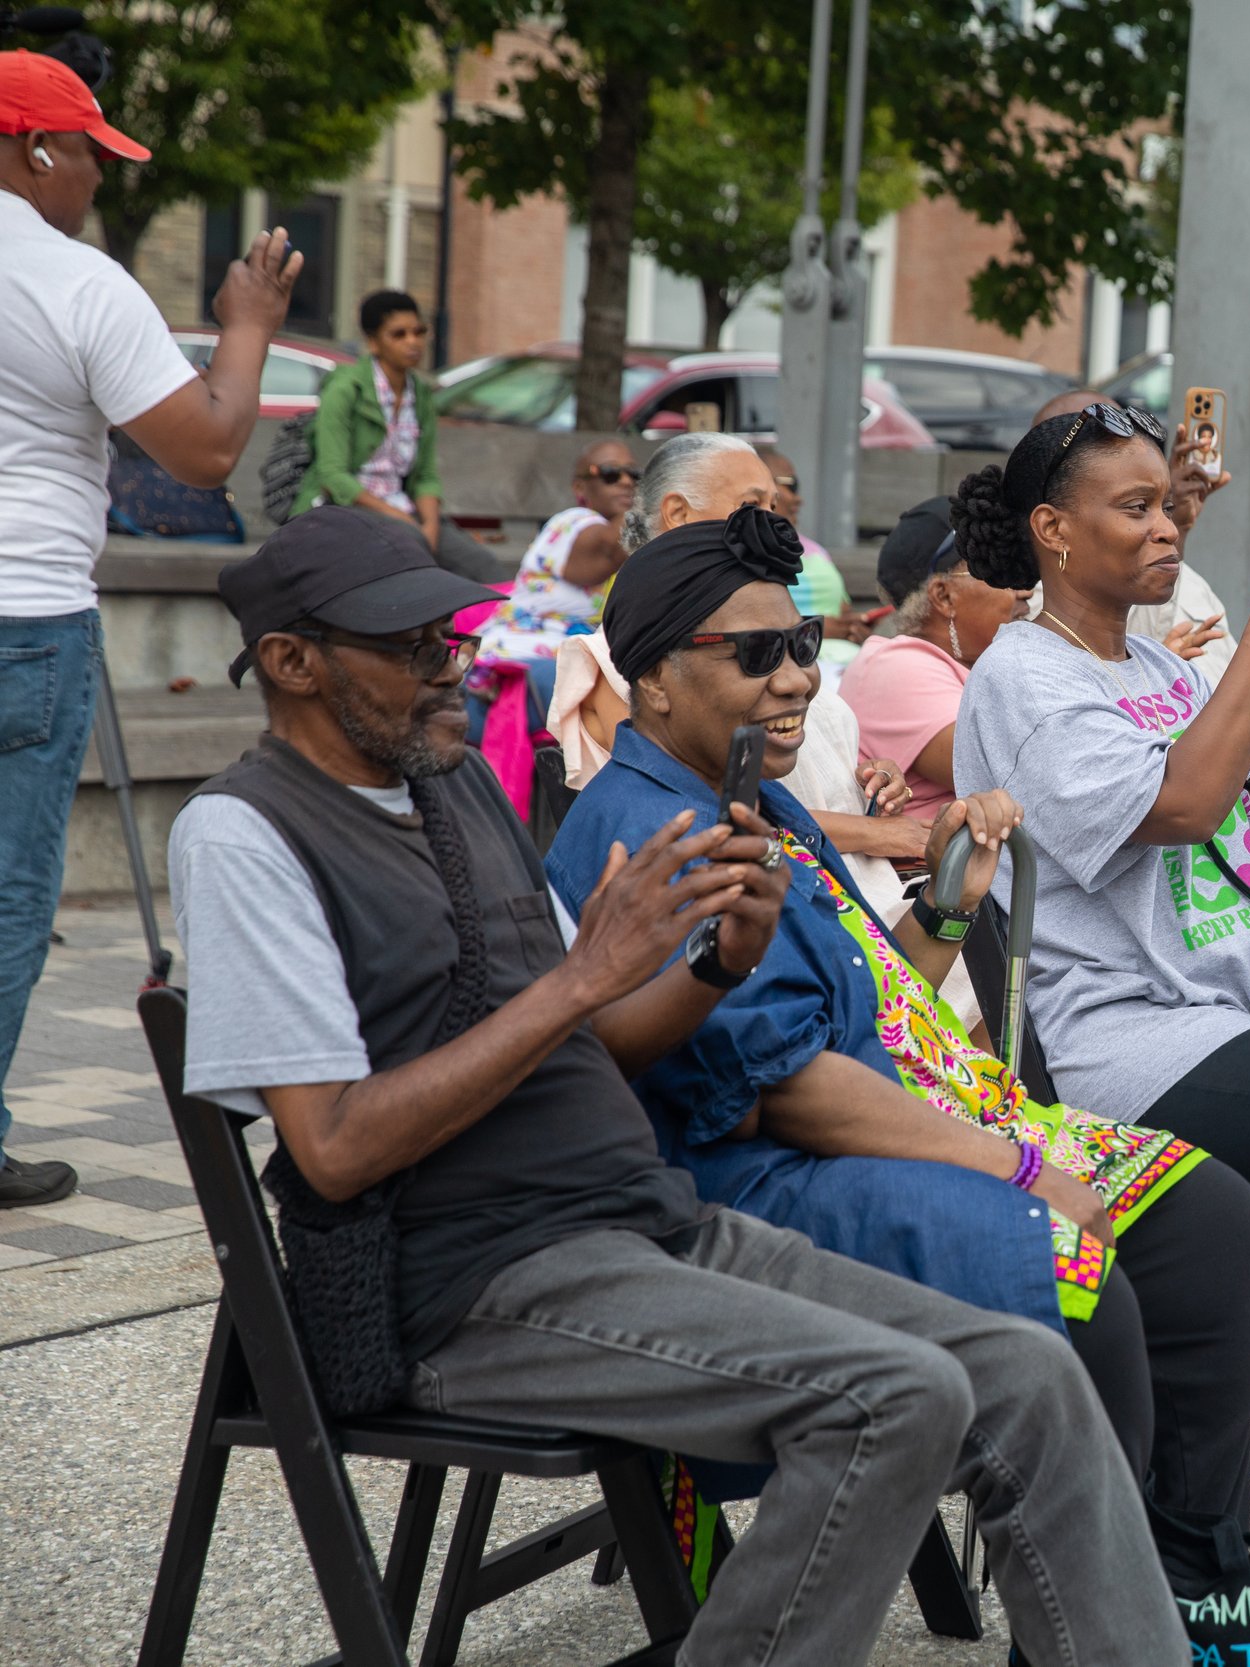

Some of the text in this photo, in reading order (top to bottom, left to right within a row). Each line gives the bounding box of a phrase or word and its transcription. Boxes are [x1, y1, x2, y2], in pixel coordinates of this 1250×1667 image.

[1062, 418, 1084, 448] GUCCI
[1162, 847, 1191, 919] TRUST
[1181, 913, 1236, 952] KEEP
